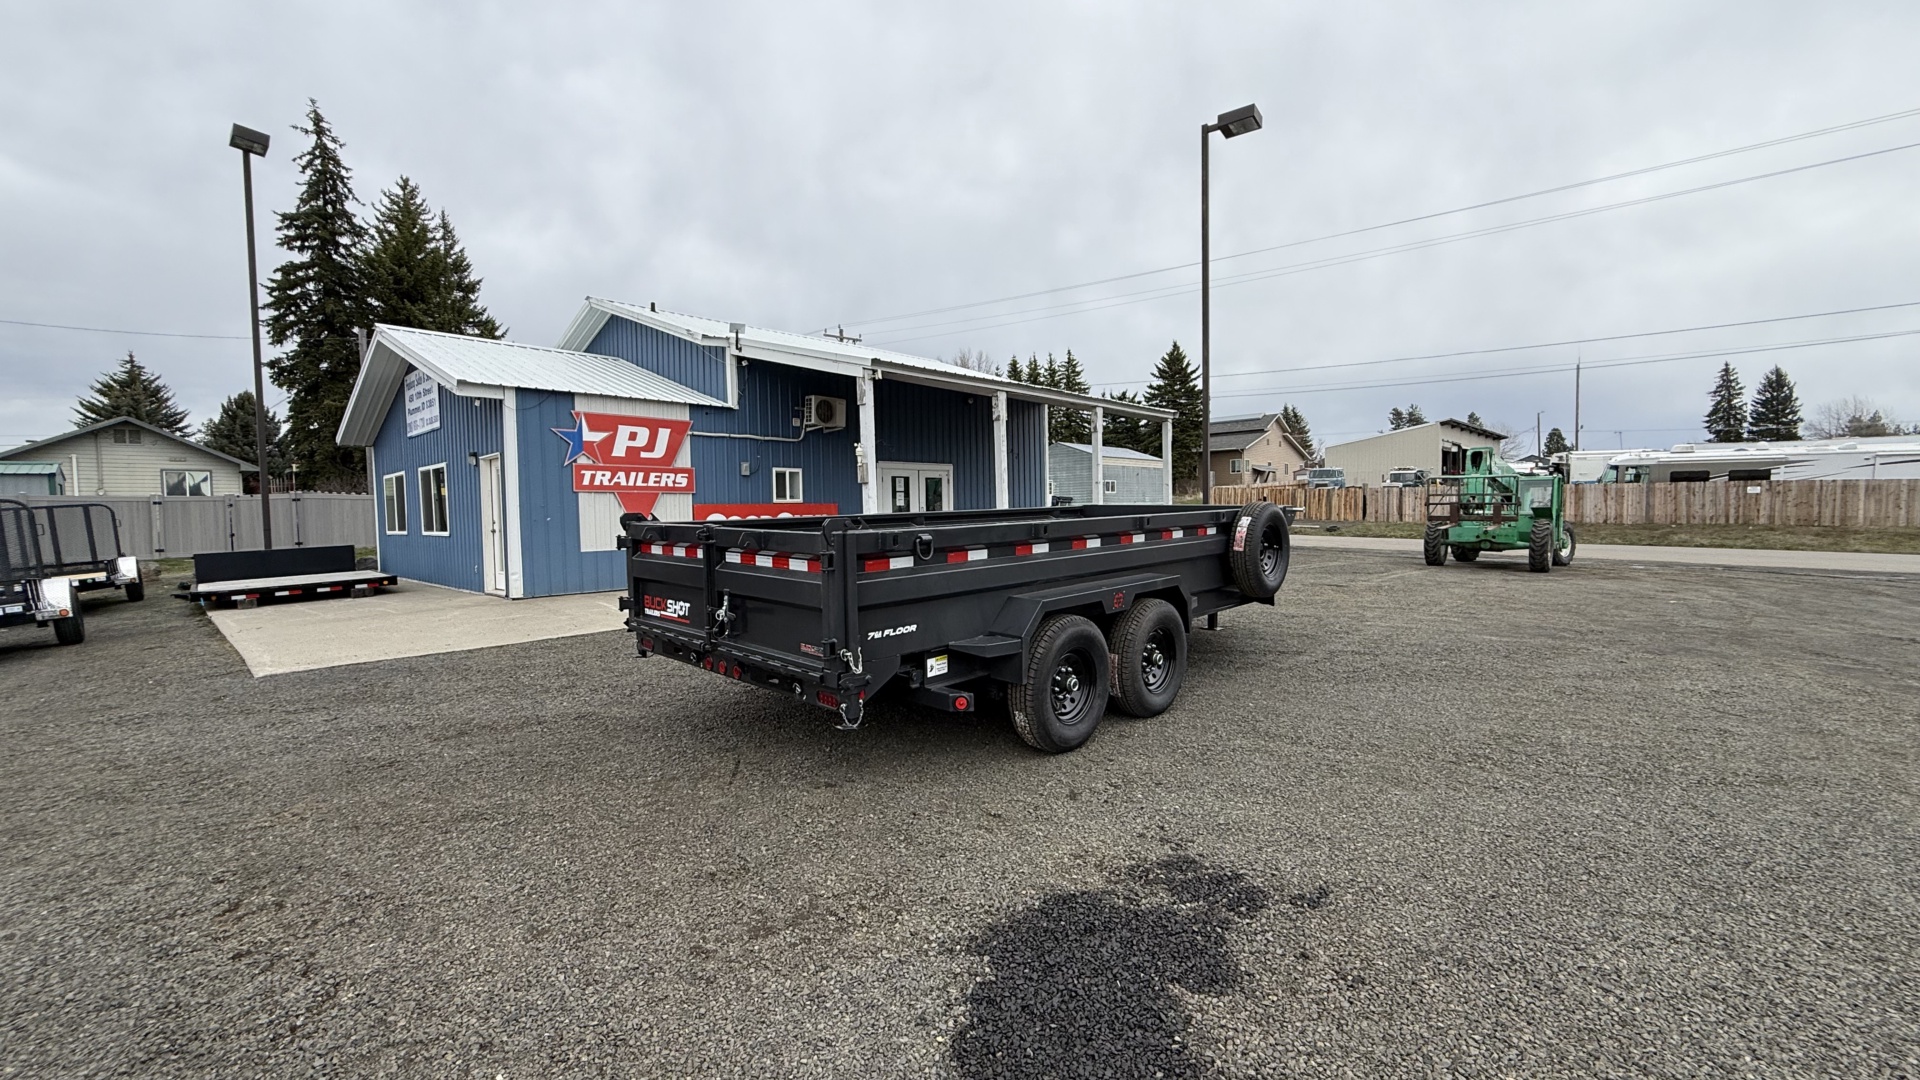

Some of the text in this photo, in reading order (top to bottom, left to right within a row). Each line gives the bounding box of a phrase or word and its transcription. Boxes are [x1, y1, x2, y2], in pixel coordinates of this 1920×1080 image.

[611, 424, 672, 459] PJ
[580, 469, 689, 488] TRAILERS
[882, 623, 918, 638] FLOOR
